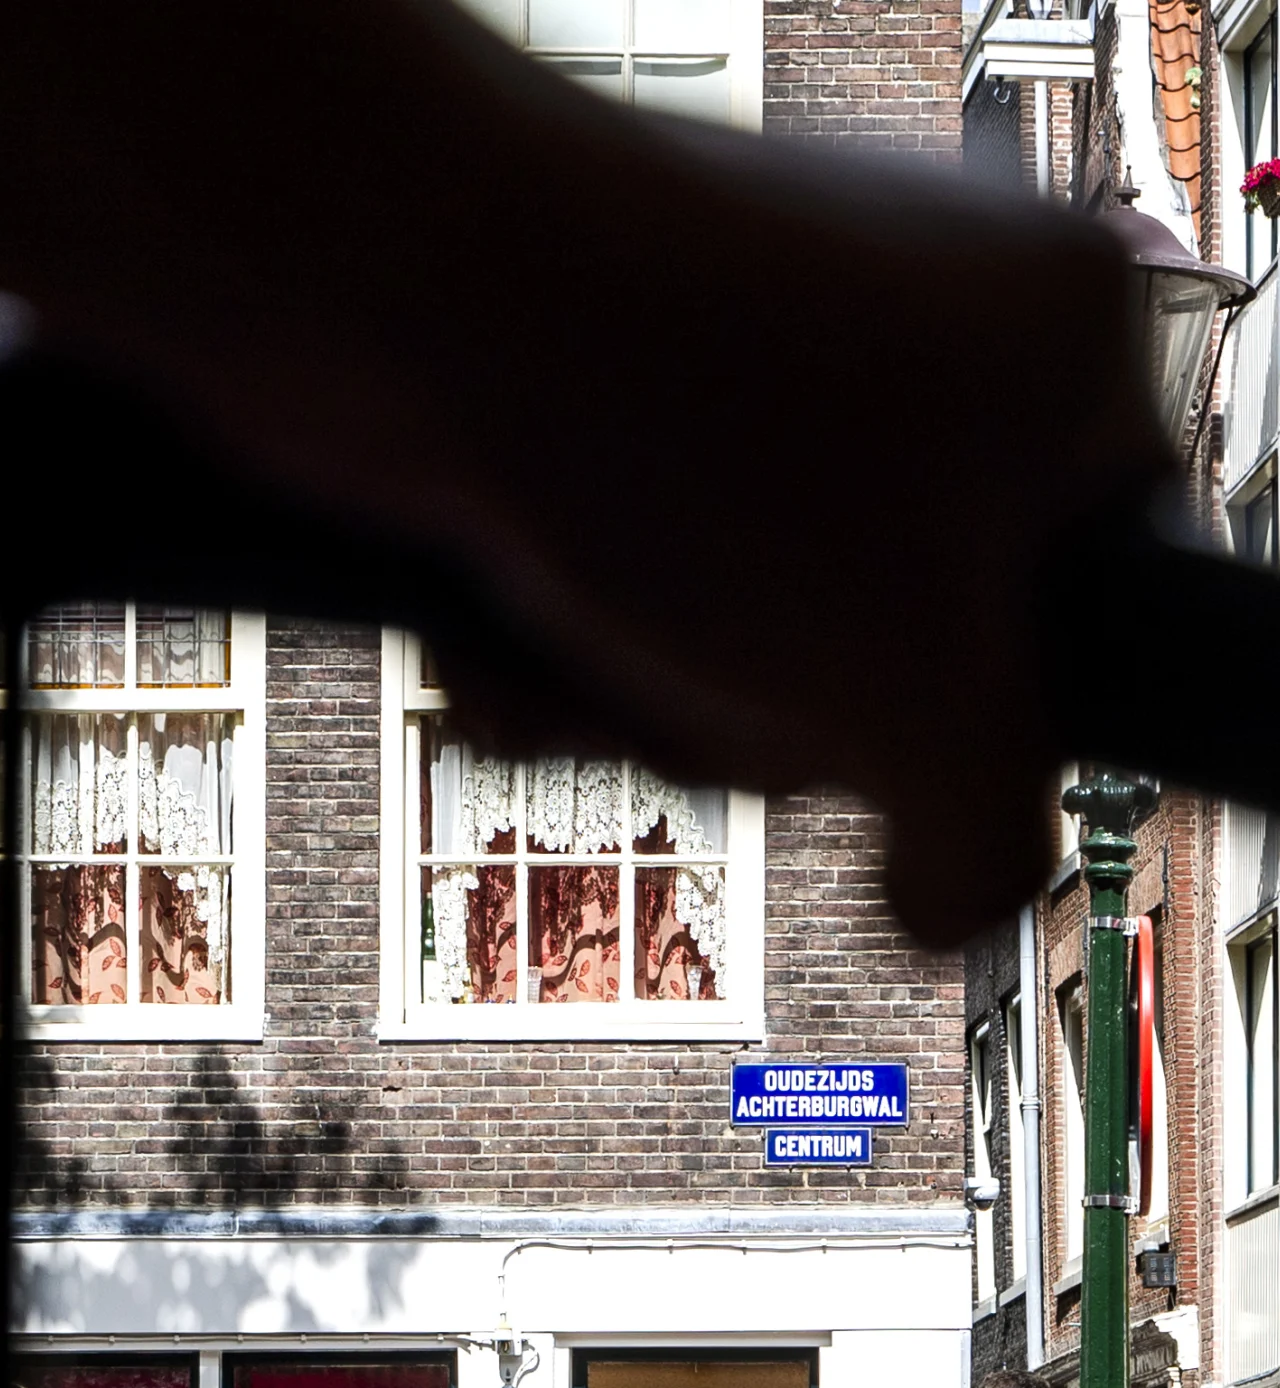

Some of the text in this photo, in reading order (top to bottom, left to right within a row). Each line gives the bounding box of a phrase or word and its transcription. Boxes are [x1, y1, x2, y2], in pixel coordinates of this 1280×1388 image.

[764, 1070, 874, 1092] OUDEZIJDS
[736, 1096, 903, 1117] ACHTERBURGWAL
[774, 1135, 862, 1157] CENTRUM
